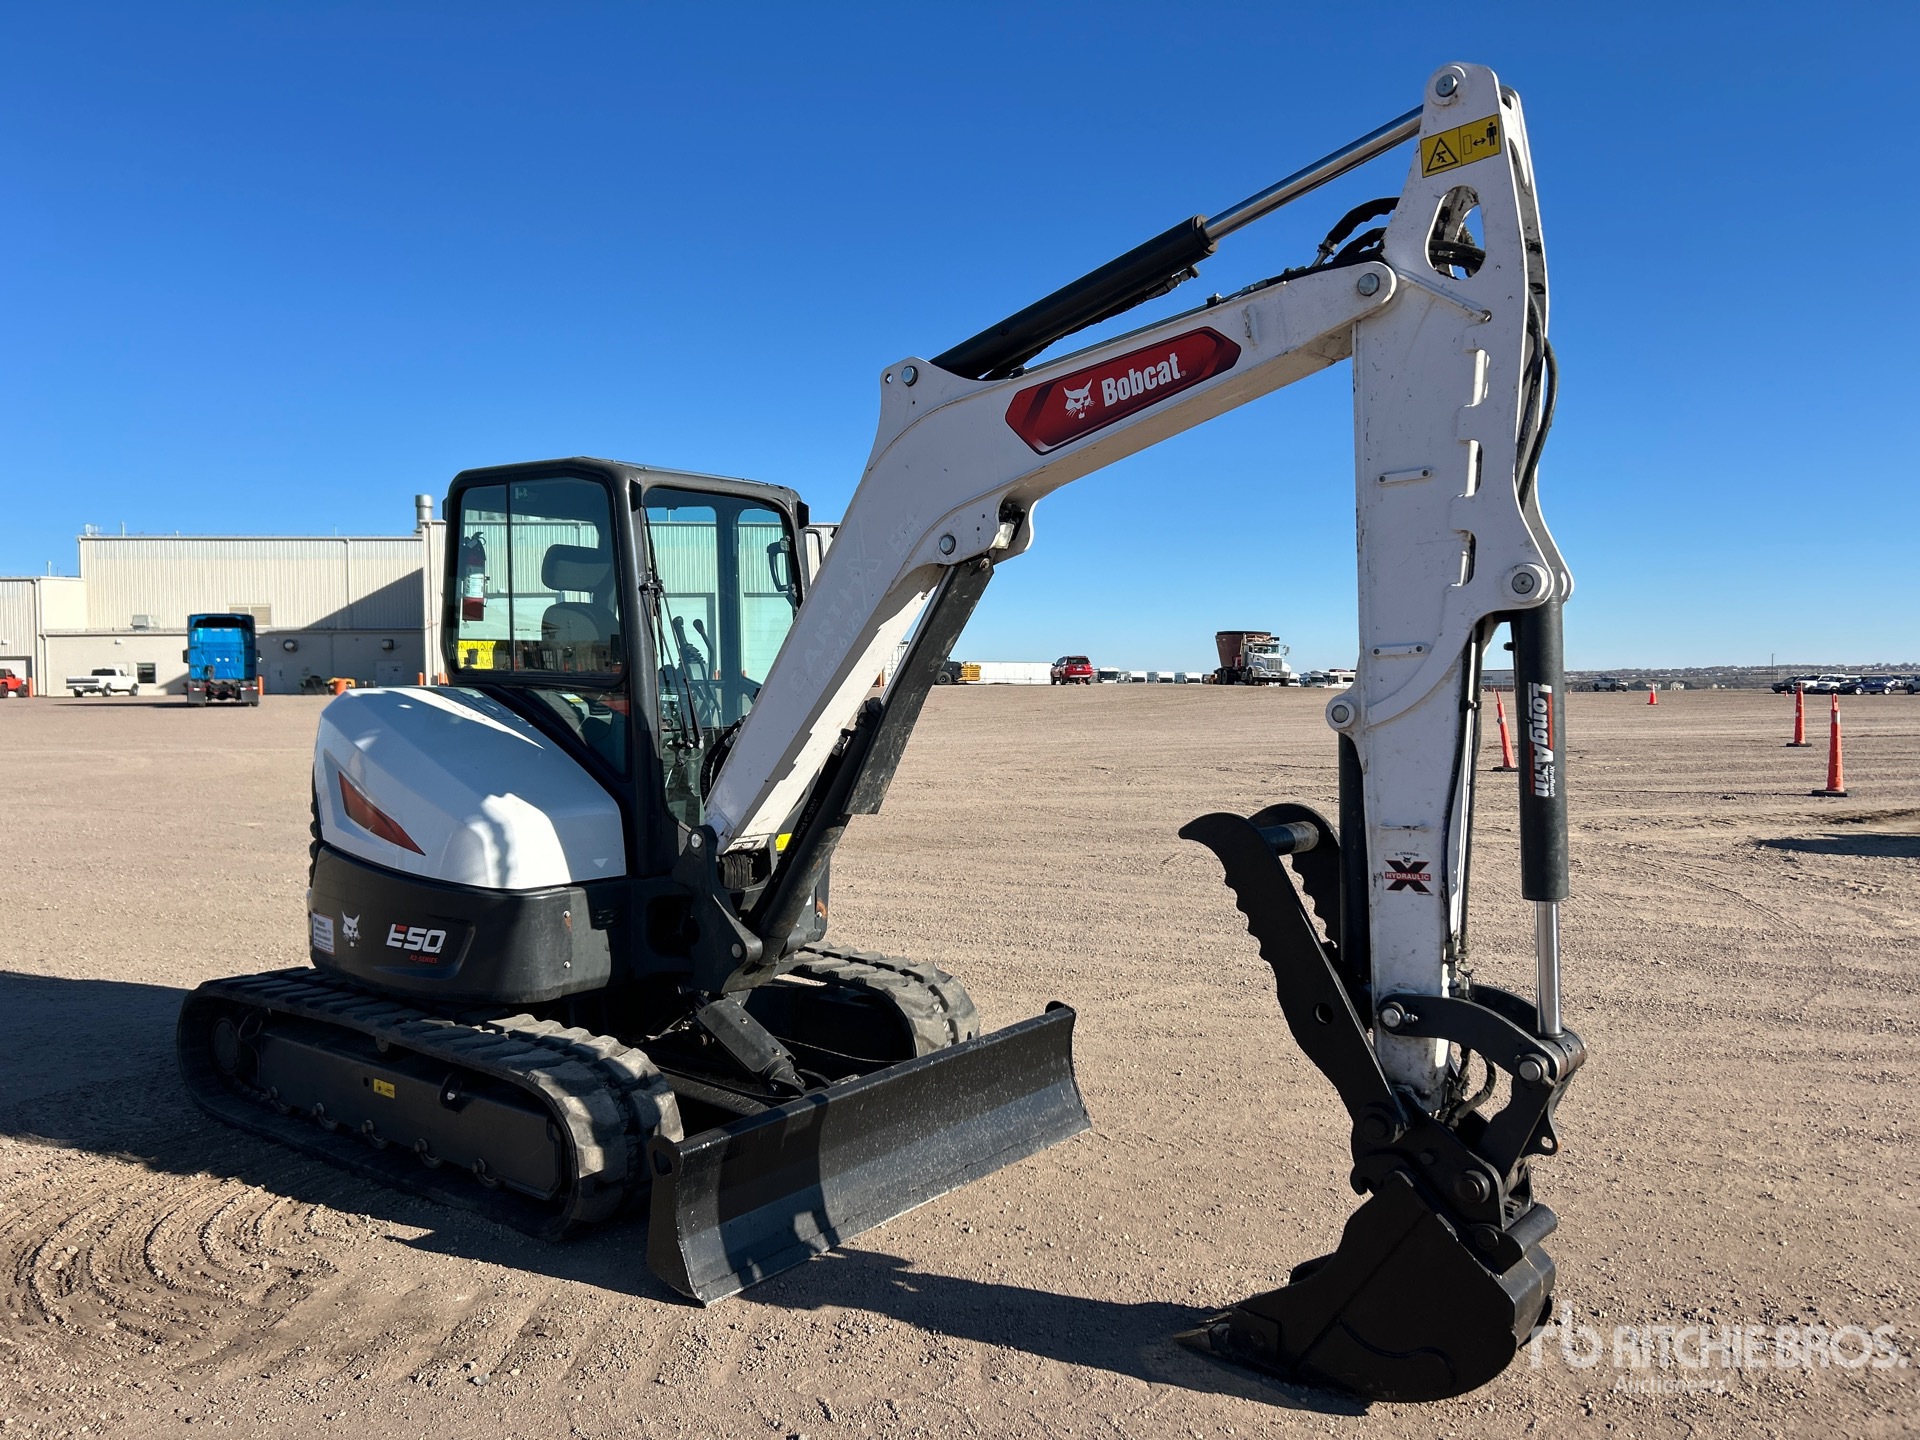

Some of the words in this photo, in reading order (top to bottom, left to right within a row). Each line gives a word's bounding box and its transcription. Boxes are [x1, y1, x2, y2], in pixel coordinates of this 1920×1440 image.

[1102, 352, 1181, 407] Bobcat
[1386, 872, 1430, 881] HYDRAULIC
[386, 923, 446, 954] E50
